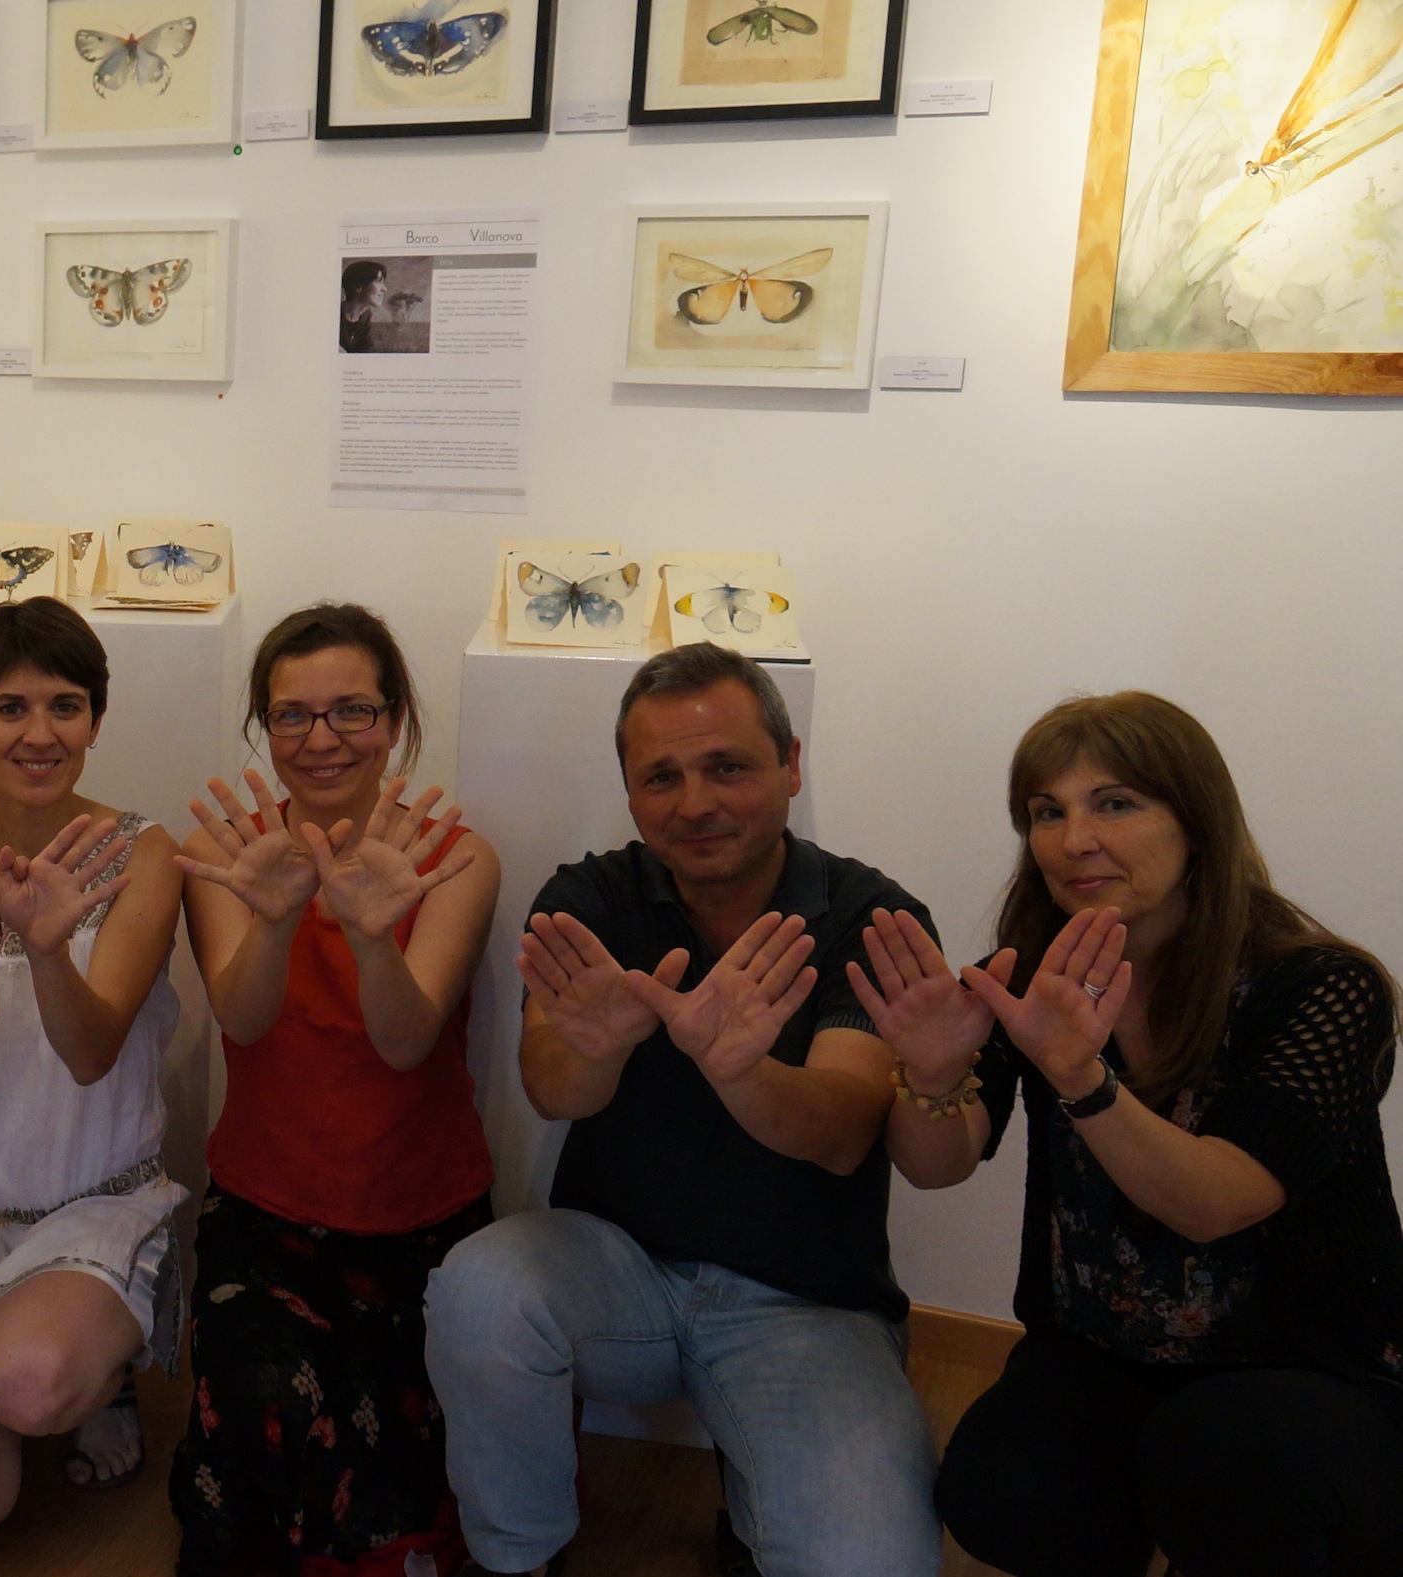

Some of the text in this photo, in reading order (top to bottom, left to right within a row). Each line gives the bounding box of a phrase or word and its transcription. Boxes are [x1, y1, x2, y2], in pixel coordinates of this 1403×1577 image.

[346, 228, 523, 245] Lara Barco Villanova
